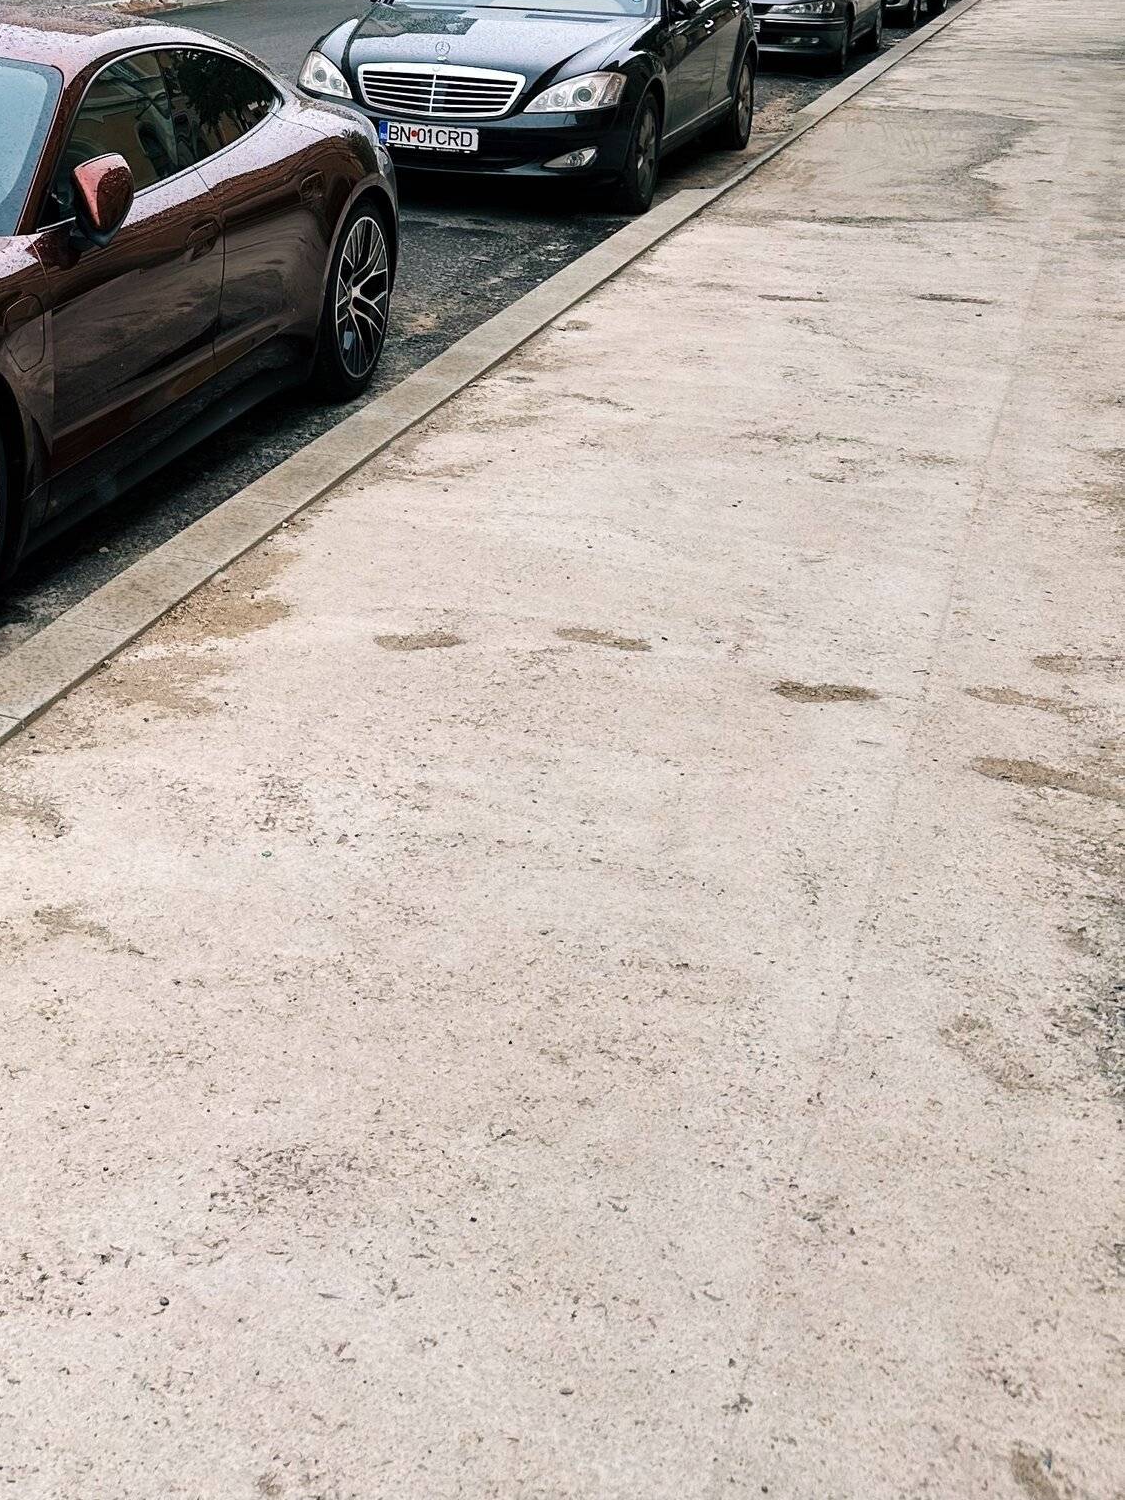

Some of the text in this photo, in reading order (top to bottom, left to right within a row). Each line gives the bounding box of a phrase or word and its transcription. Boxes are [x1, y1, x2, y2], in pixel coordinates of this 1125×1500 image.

[389, 124, 411, 142] BN
[417, 128, 432, 144] 01
[436, 130, 472, 147] CRD
